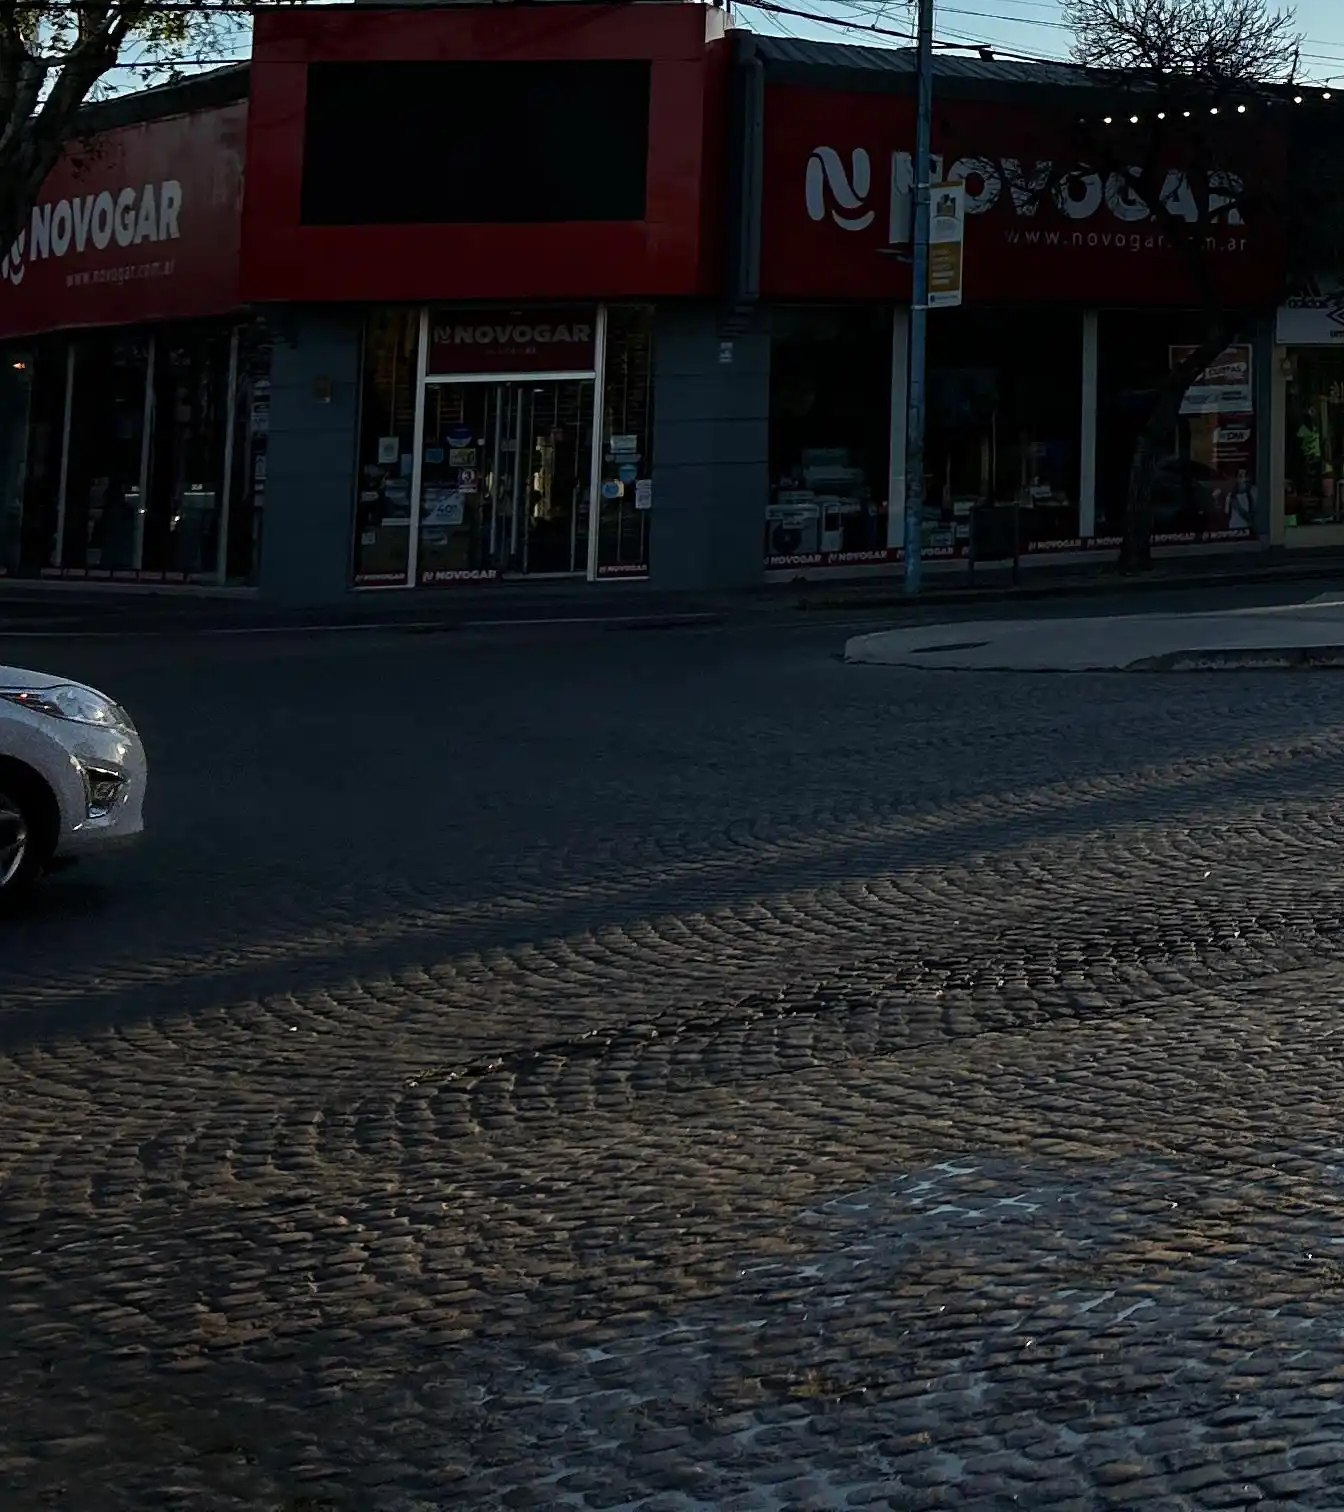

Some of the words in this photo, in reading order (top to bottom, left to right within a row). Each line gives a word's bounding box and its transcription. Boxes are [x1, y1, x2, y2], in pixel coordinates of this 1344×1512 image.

[30, 180, 182, 262] NOVOGAR
[1003, 225, 1248, 253] www.novogar.m.ar
[454, 323, 592, 345] NOVOGAR
[771, 554, 822, 565] NOVOGAR
[435, 569, 498, 581] NOVOGAR
